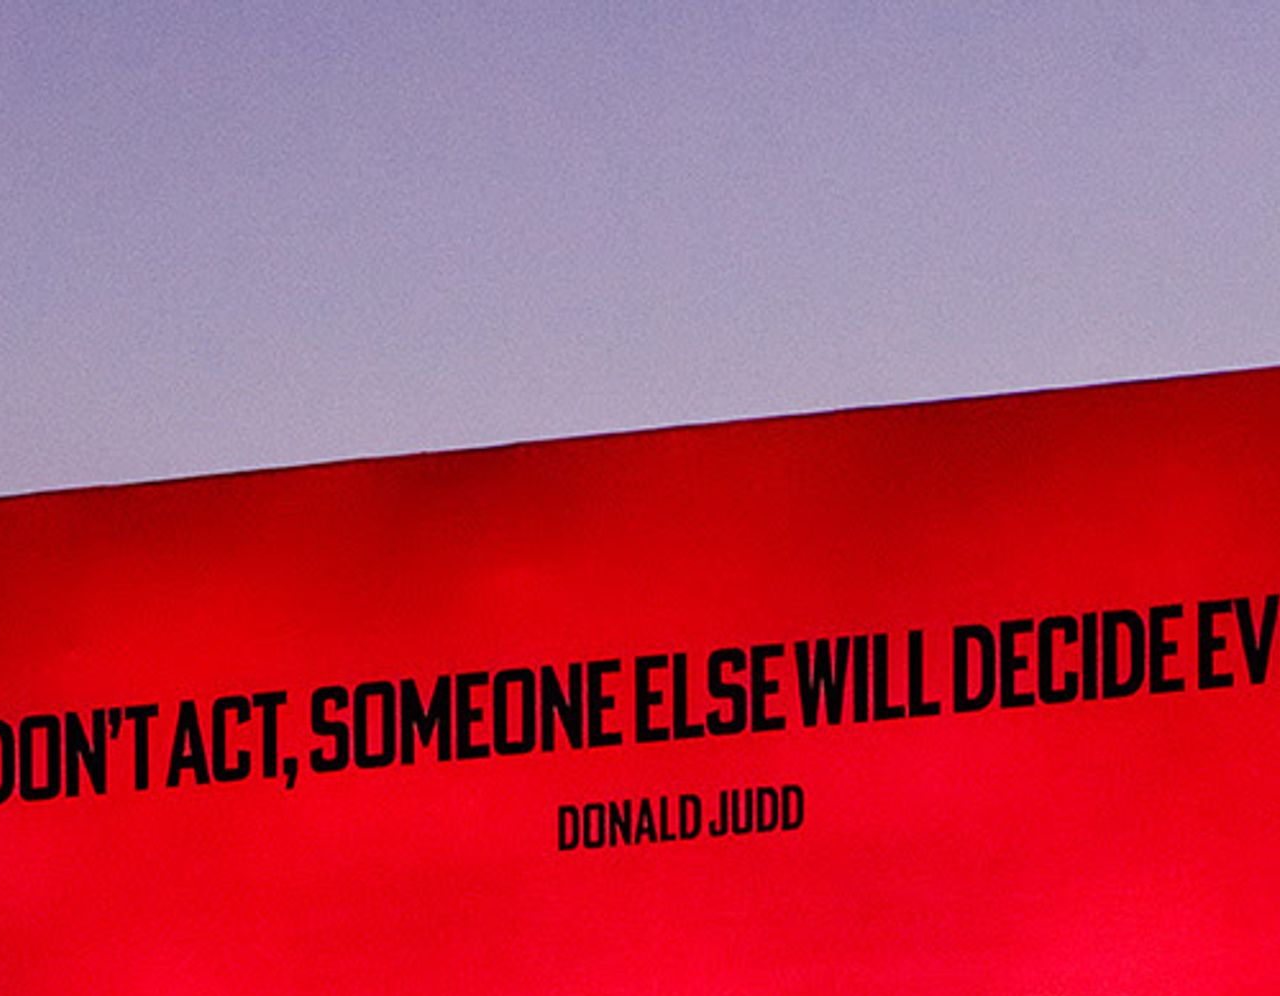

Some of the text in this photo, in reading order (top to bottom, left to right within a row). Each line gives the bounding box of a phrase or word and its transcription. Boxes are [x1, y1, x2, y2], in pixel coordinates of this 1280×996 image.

[165, 689, 299, 791] ACT,
[309, 657, 624, 774] SOMEONE
[634, 642, 787, 744] ELSE
[793, 628, 942, 728] WILL
[952, 603, 1186, 714] DECIDE
[557, 783, 805, 852] DONALD JUDD
